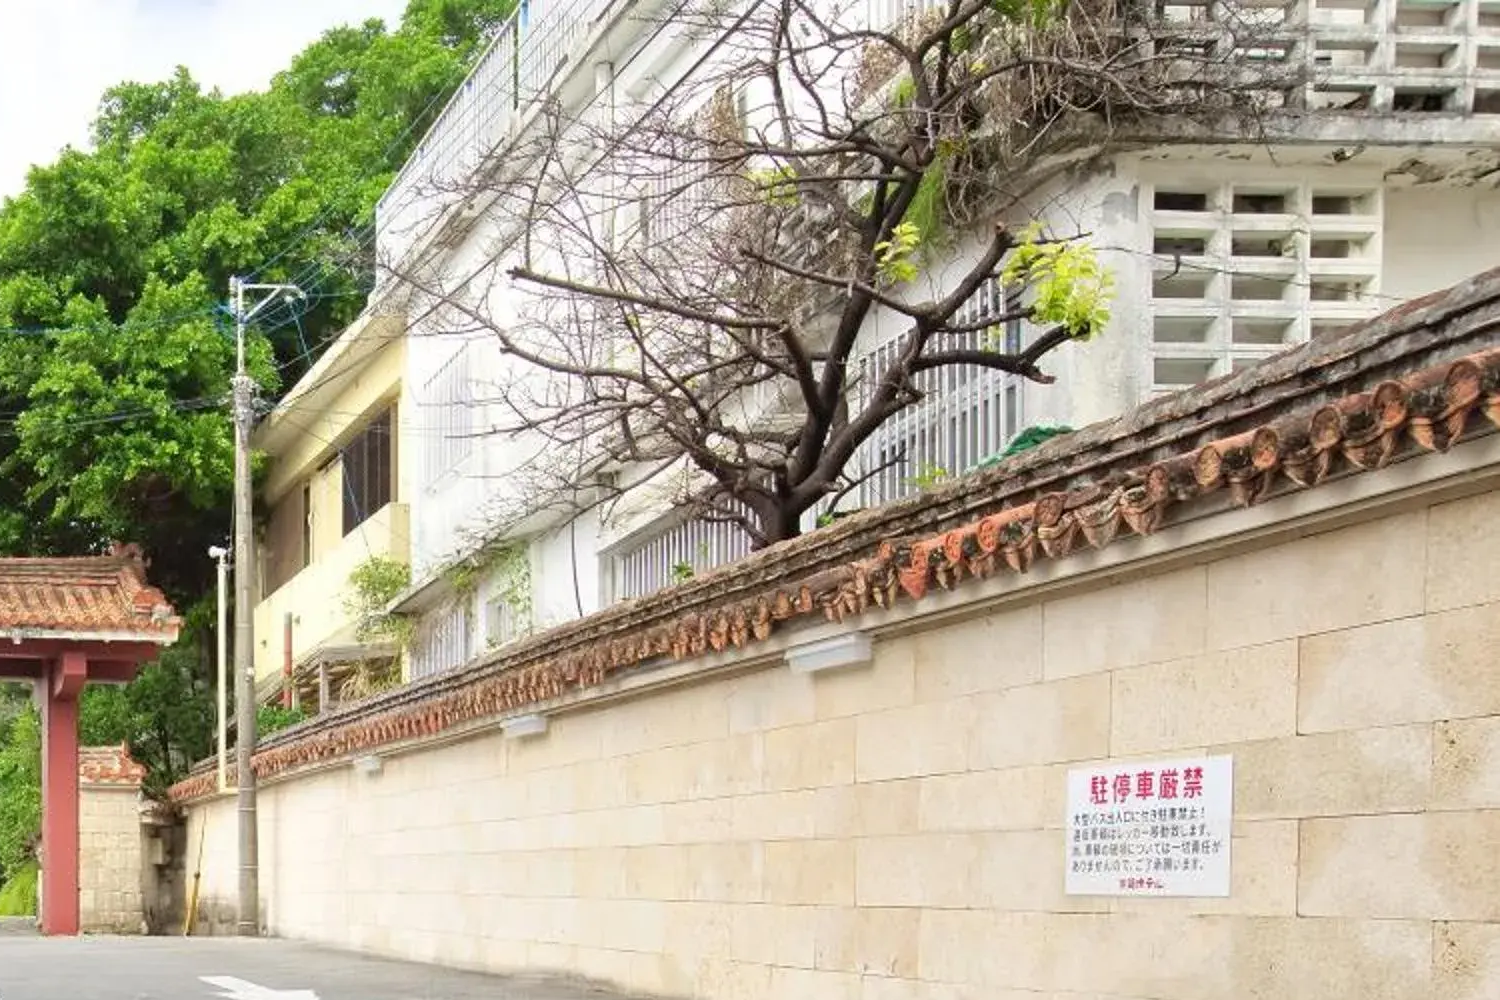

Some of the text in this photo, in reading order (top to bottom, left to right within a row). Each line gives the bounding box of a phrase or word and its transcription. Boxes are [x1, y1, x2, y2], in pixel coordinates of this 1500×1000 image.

[1090, 767, 1203, 805] 駐停車厳禁
